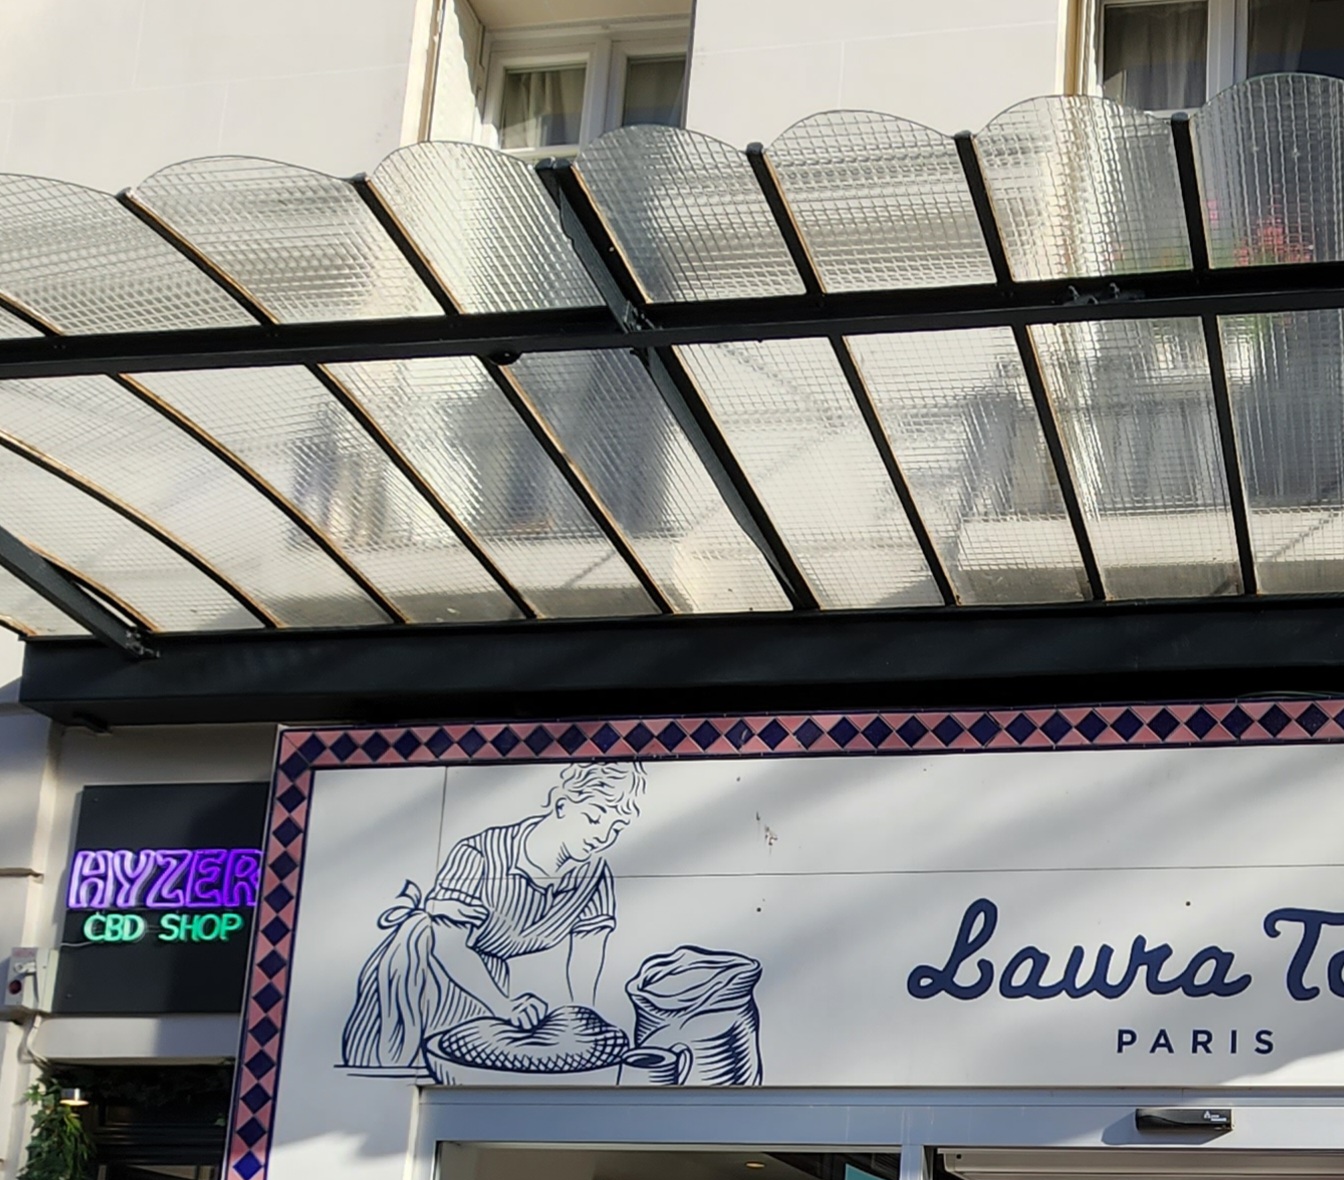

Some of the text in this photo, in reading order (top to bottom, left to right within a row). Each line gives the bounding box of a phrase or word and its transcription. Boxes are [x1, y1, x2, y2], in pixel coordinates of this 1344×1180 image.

[68, 848, 263, 909] HYZER
[83, 912, 244, 942] CBD SHOP
[907, 898, 1252, 1001] Laura
[1116, 1028, 1275, 1055] PARIS
